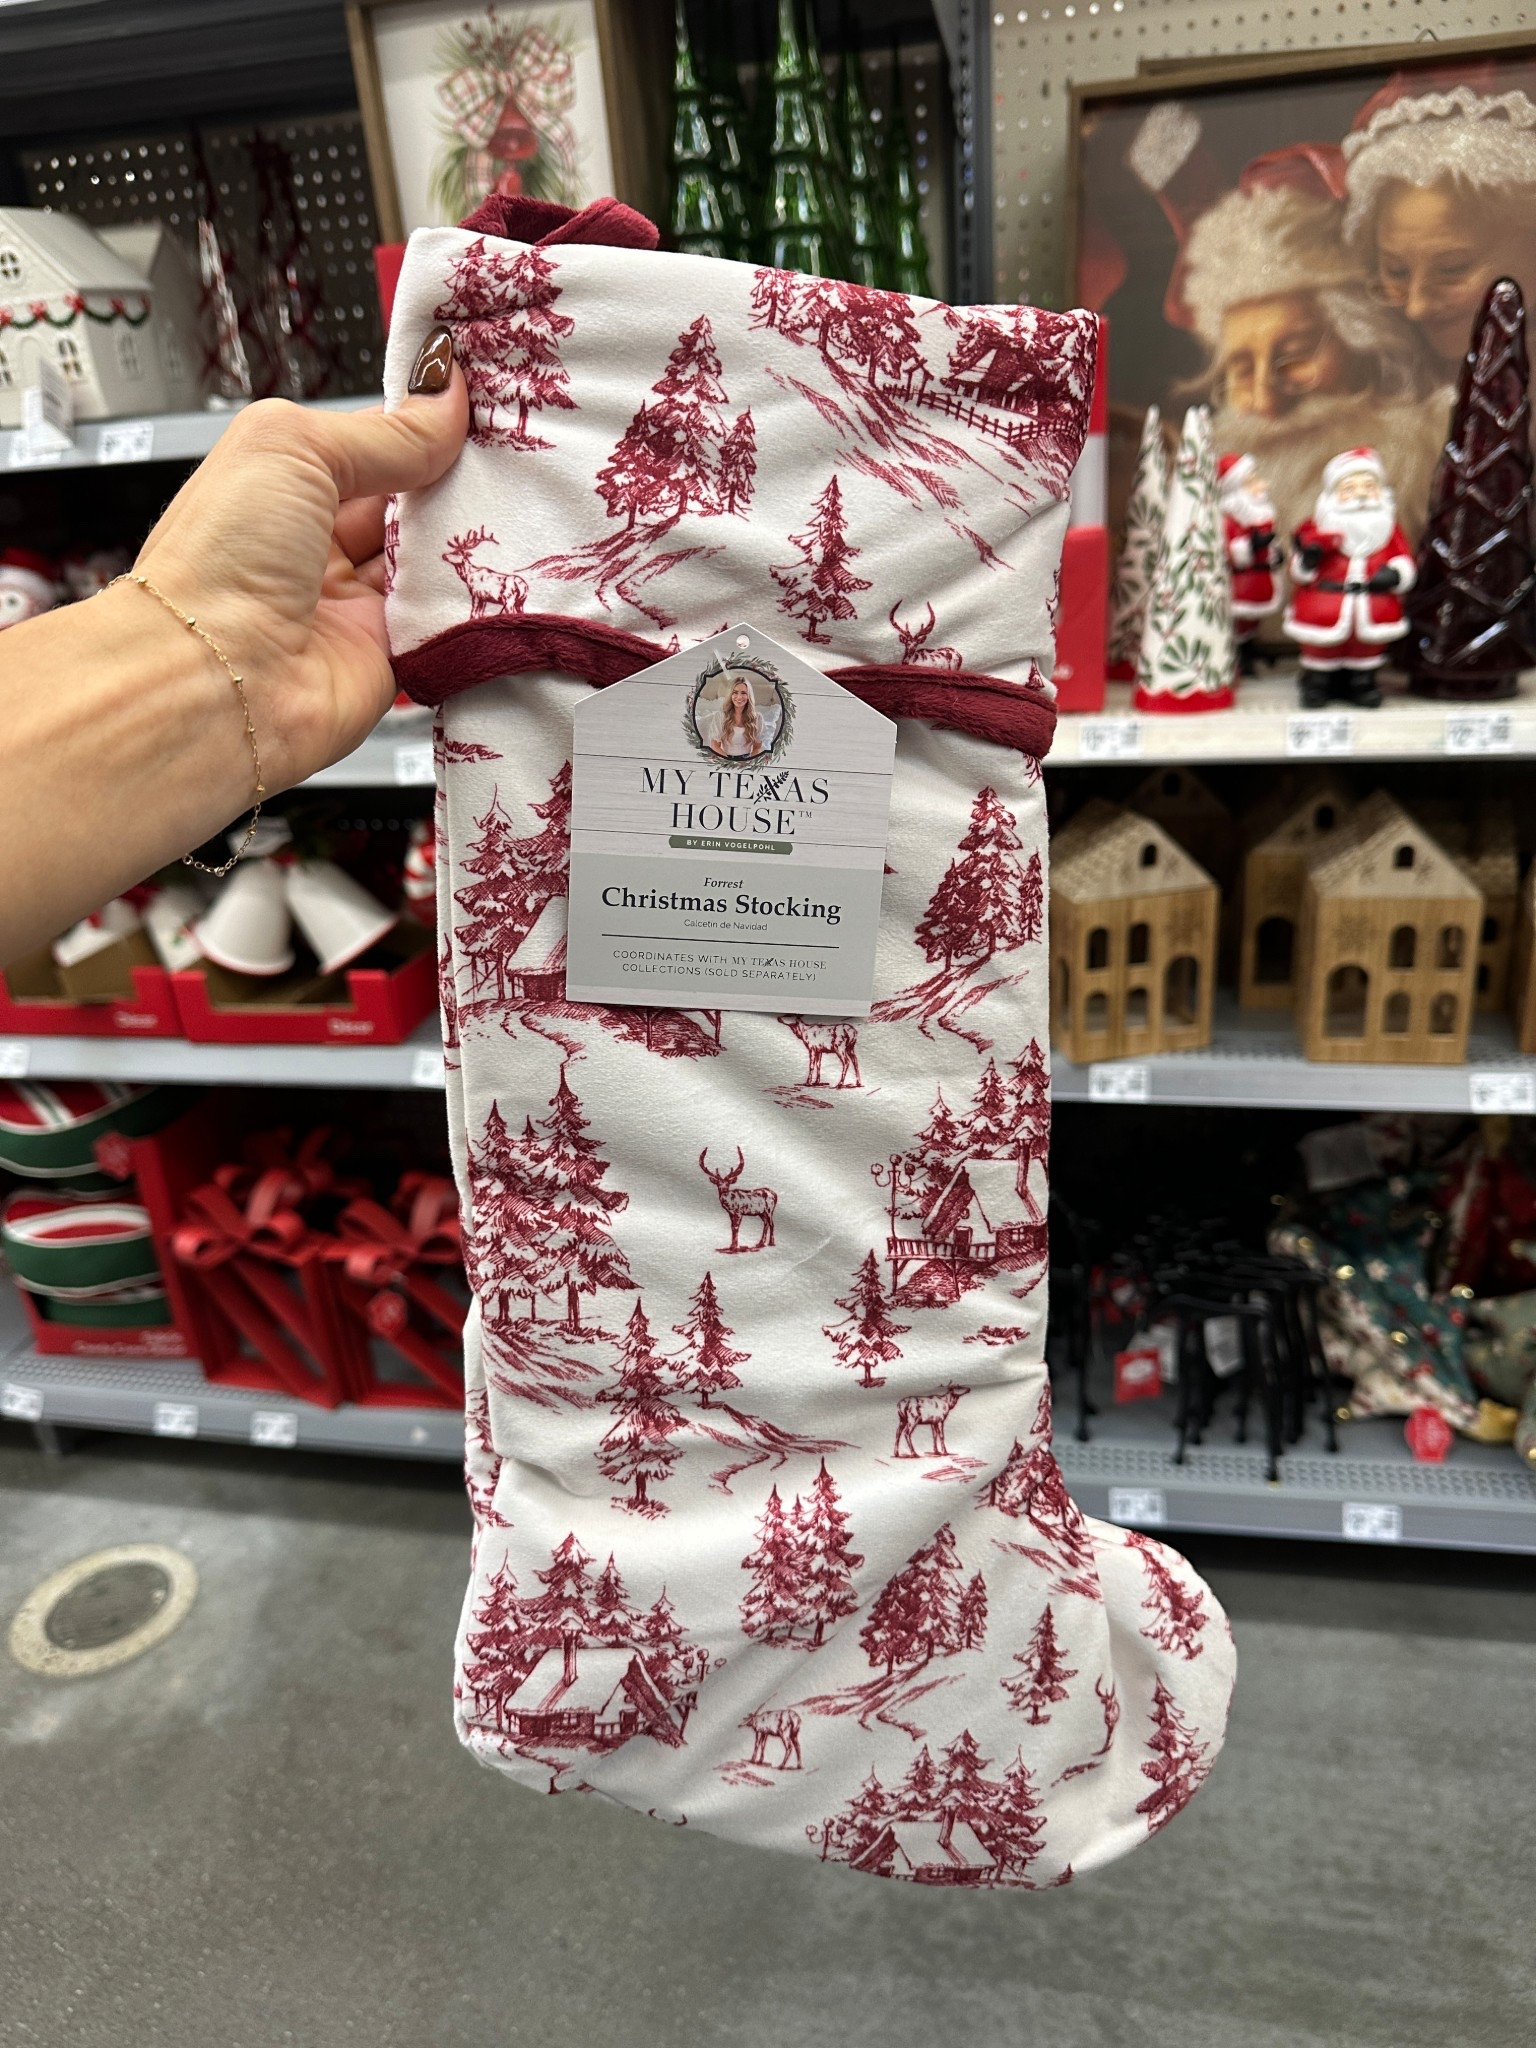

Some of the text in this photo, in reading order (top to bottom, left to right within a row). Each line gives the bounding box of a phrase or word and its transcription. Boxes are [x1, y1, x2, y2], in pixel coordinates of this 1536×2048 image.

[639, 767, 829, 804] MY TEXAS
[686, 839, 776, 851] BY ERIN VOGELPOHL
[703, 877, 744, 889] Forrest
[601, 886, 842, 926] Christmas Stocking
[720, 921, 731, 930] de
[733, 922, 768, 931] Navidad
[613, 950, 827, 970] COORDINATES WITH MY TEXAS HOUSE
[622, 963, 816, 981] COLLECTIONS (SOLD SEPARATELY)
